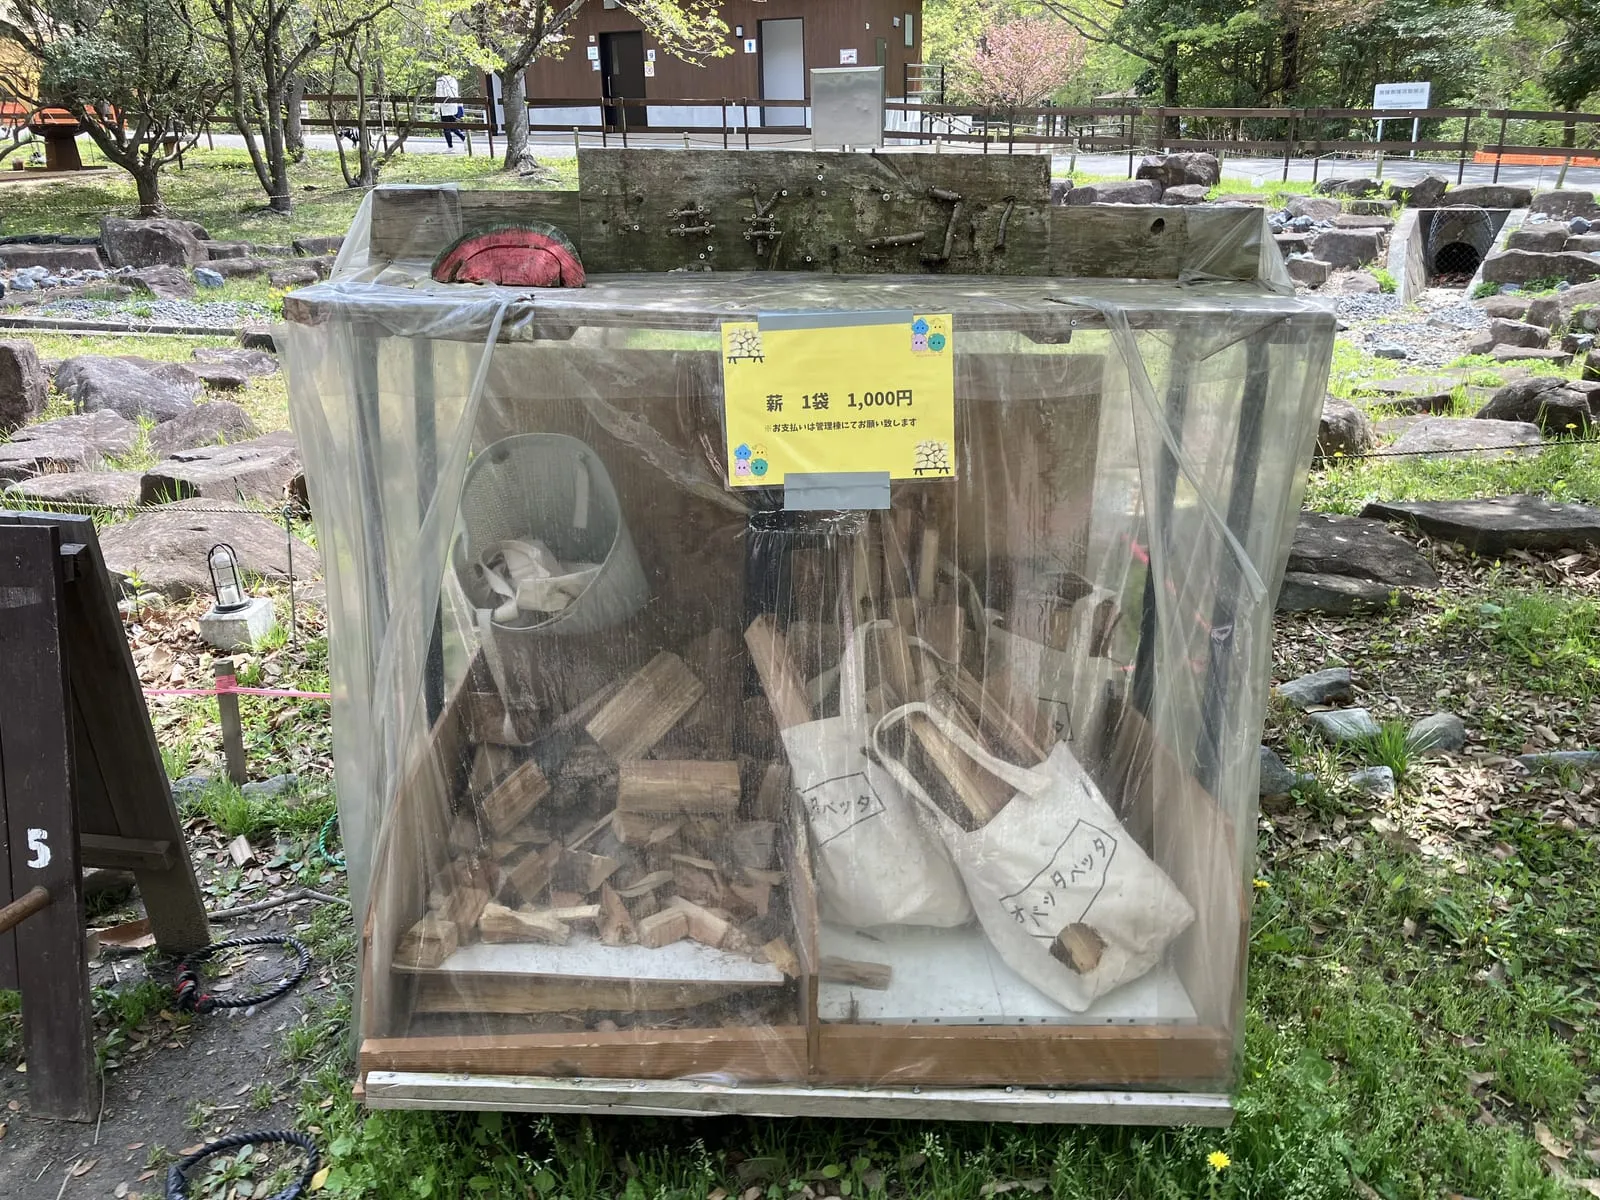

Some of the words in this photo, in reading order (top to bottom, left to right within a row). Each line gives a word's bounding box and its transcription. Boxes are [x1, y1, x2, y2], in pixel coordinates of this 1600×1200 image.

[766, 394, 783, 412] 薪
[802, 393, 829, 410] 1袋
[847, 389, 913, 410] 1,000円
[765, 418, 917, 433] ※お支払いは管理棟にてお願い致します
[27, 828, 51, 869] 5
